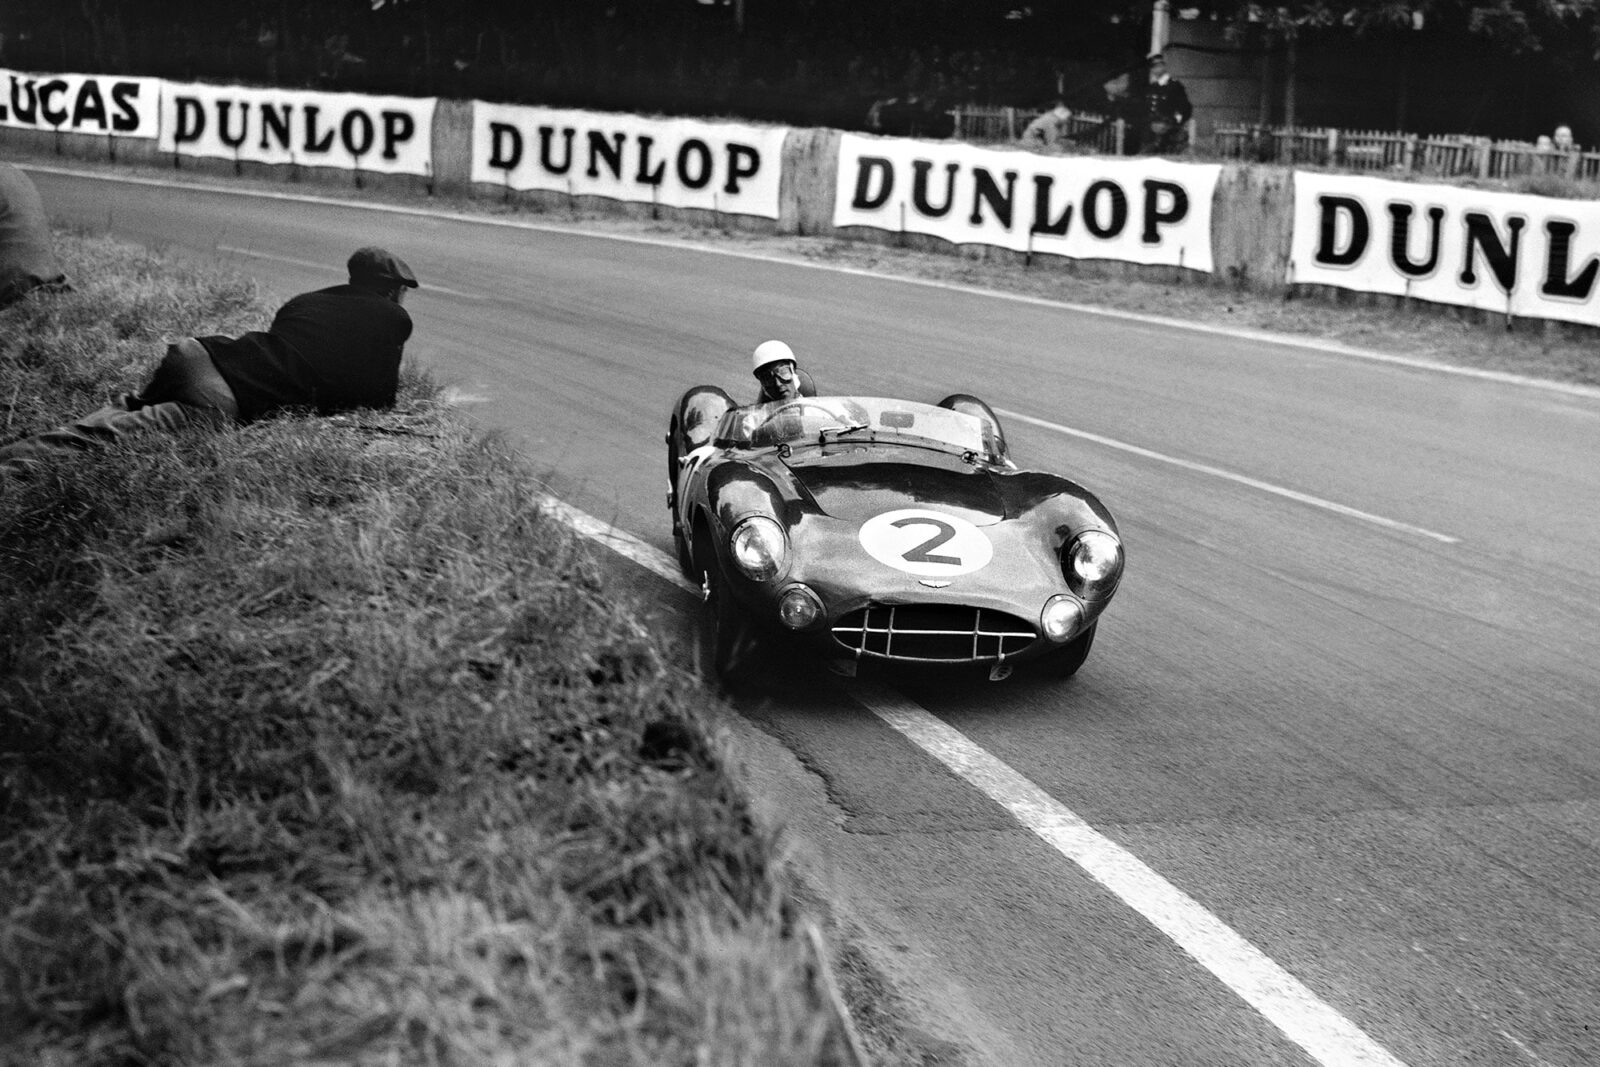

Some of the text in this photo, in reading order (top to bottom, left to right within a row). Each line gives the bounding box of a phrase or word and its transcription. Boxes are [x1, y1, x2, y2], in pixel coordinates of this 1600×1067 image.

[0, 76, 140, 131] UCAS
[174, 96, 415, 159] DUNLOP
[489, 122, 760, 194] DUNLOP
[851, 155, 1190, 244] DUNLOP
[1314, 193, 1600, 302] DUNL
[889, 517, 962, 566] 2
